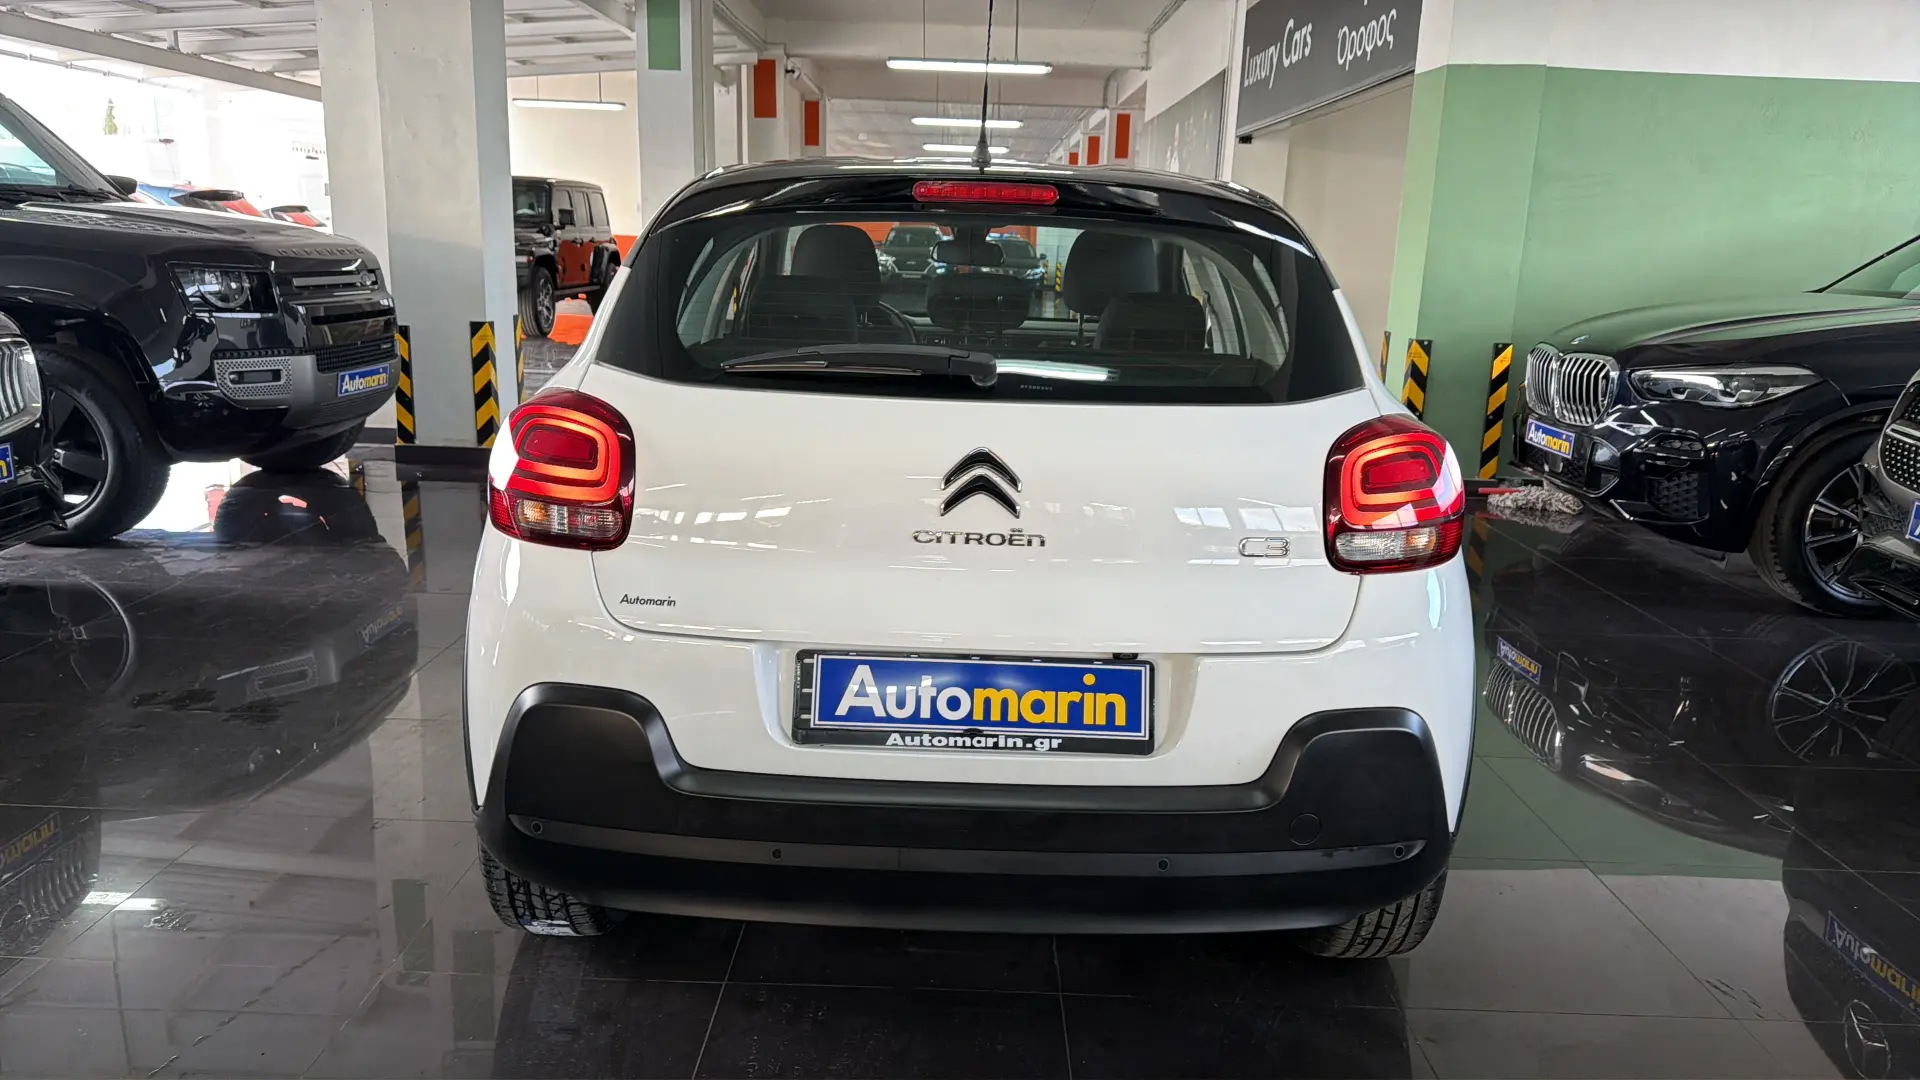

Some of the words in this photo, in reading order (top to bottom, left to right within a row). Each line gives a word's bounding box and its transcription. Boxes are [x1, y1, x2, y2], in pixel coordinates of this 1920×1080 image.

[1243, 41, 1281, 89] Luxury
[1282, 18, 1313, 68] Cars
[1337, 8, 1396, 71] Όροφος
[341, 368, 387, 393] Automarin
[1528, 423, 1570, 455] Automarin
[1238, 536, 1291, 558] C3
[619, 593, 676, 607] Automarin
[834, 664, 1127, 727] Automarin
[885, 732, 1063, 751] Automarin.gr
